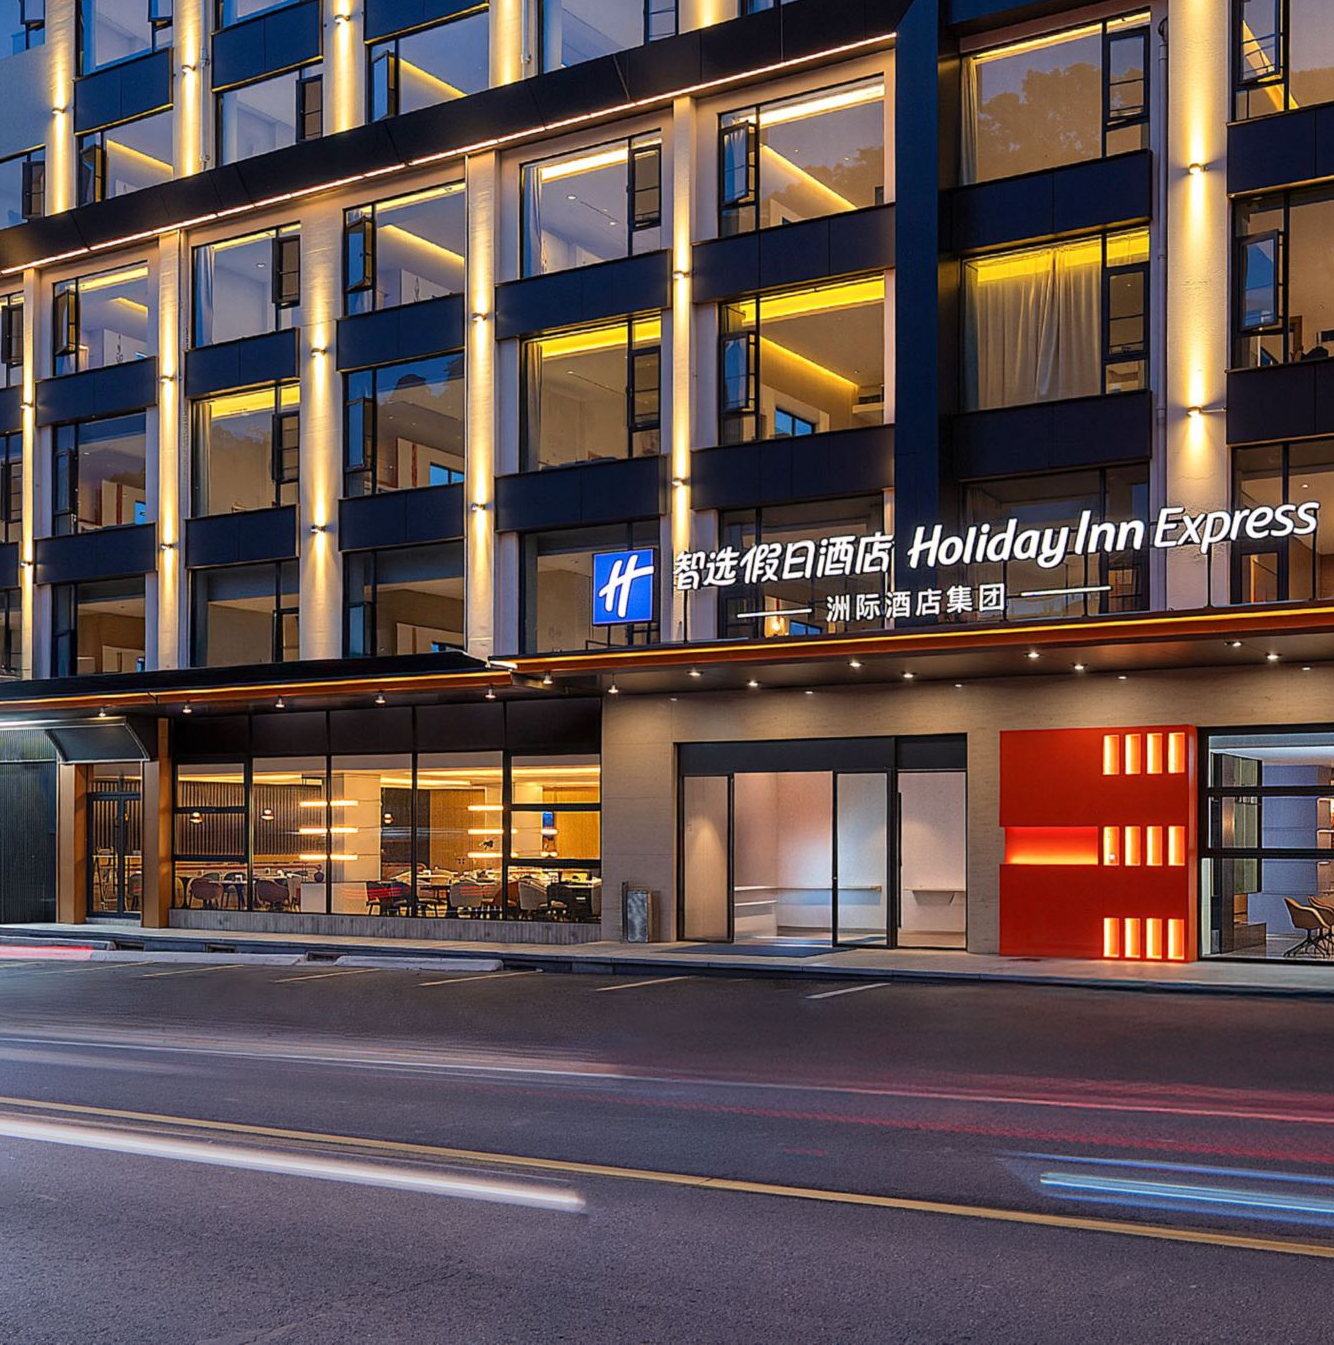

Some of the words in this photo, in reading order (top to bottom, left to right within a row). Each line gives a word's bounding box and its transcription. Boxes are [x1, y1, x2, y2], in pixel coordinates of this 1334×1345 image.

[673, 531, 895, 590] 智选假日酒店
[907, 518, 1068, 569] Holiday
[1075, 509, 1145, 555] Inn
[1154, 501, 1320, 554] Express
[825, 582, 1006, 623] 洲际酒店集团
